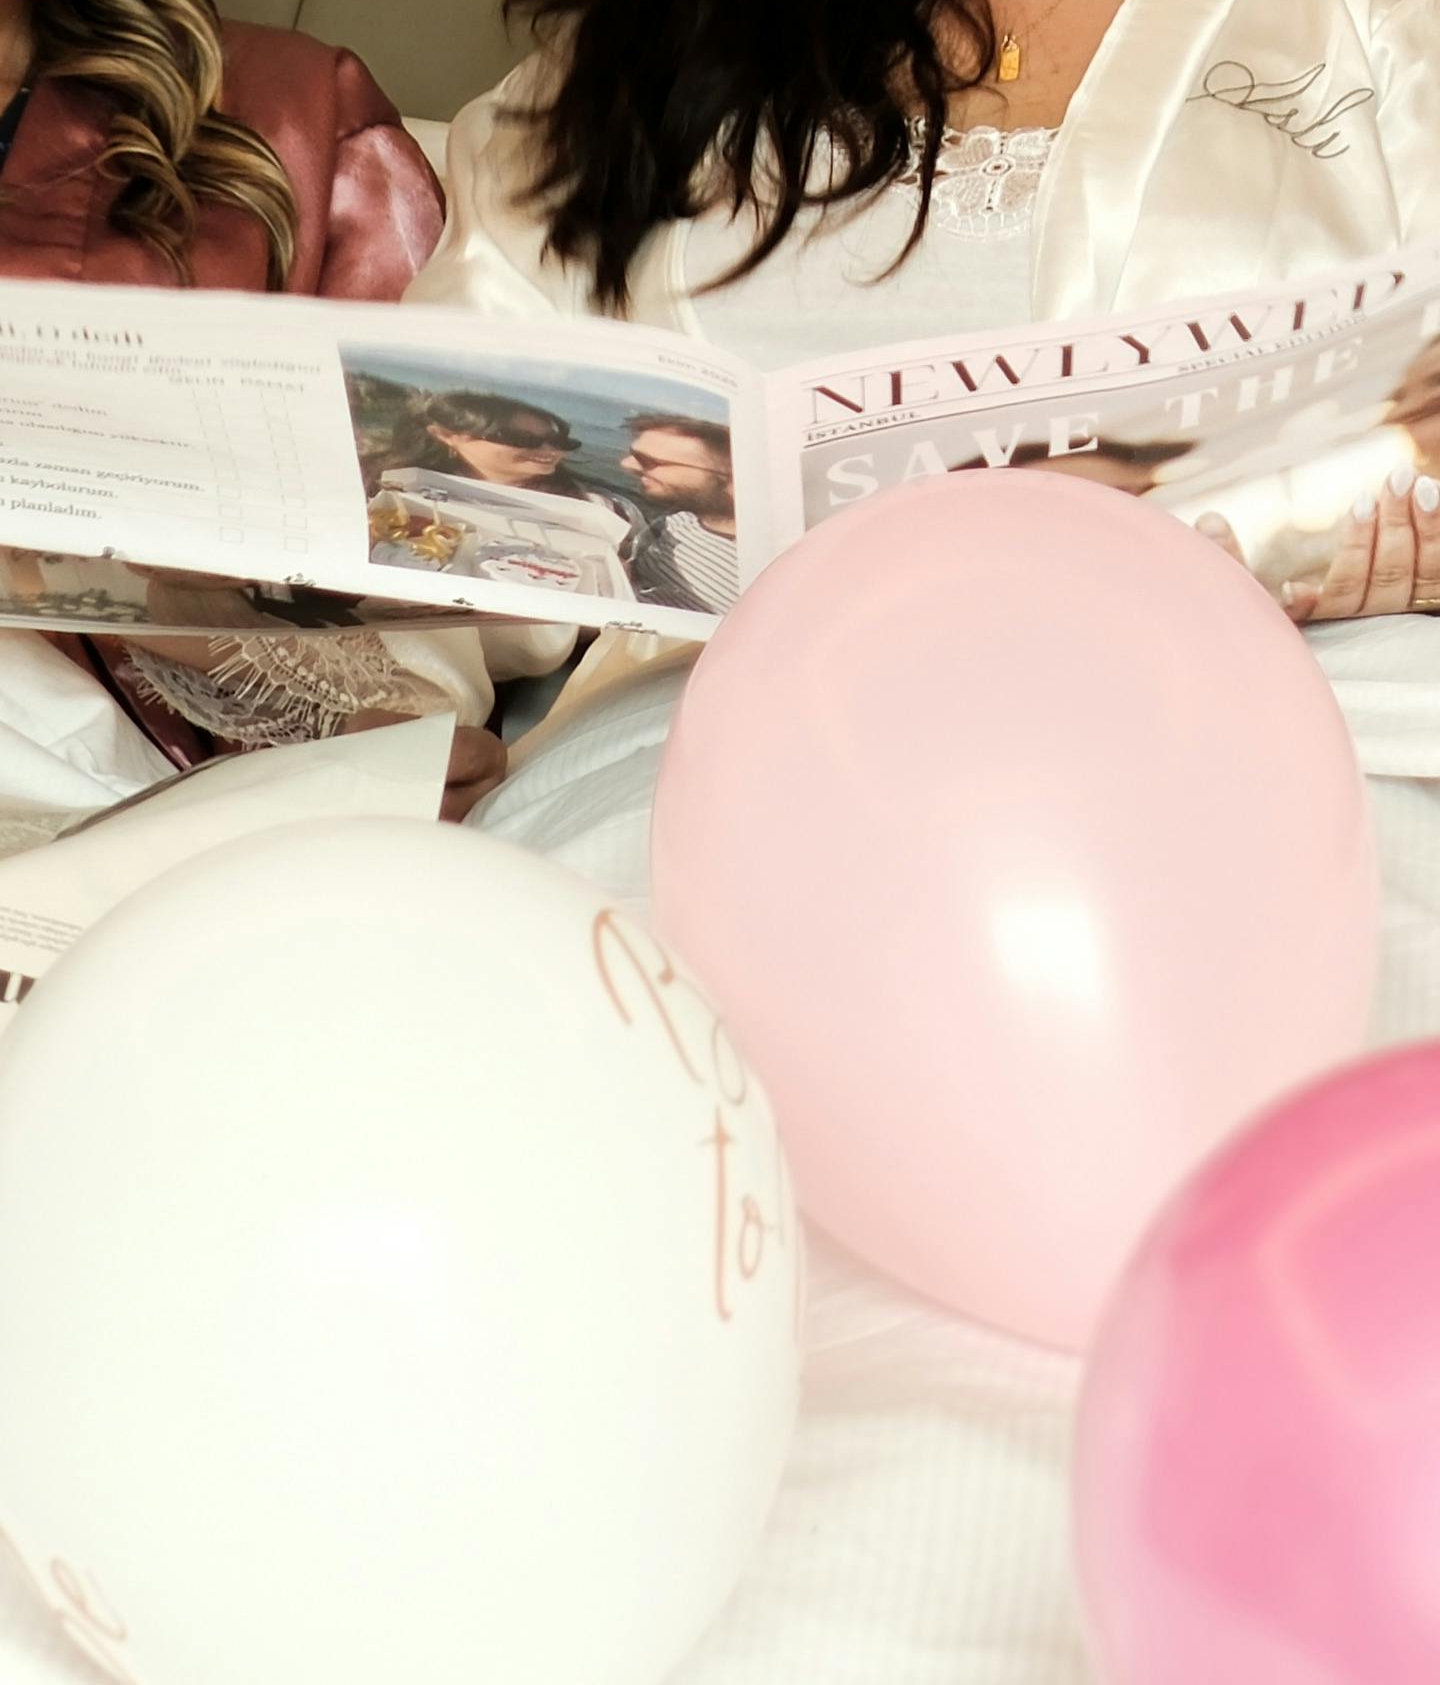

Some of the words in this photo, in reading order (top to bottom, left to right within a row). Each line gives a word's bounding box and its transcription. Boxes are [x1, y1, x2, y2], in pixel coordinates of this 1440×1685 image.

[803, 267, 1407, 426] NEWLYWED
[825, 411, 1101, 507] SAVE
[1165, 335, 1362, 431] THE
